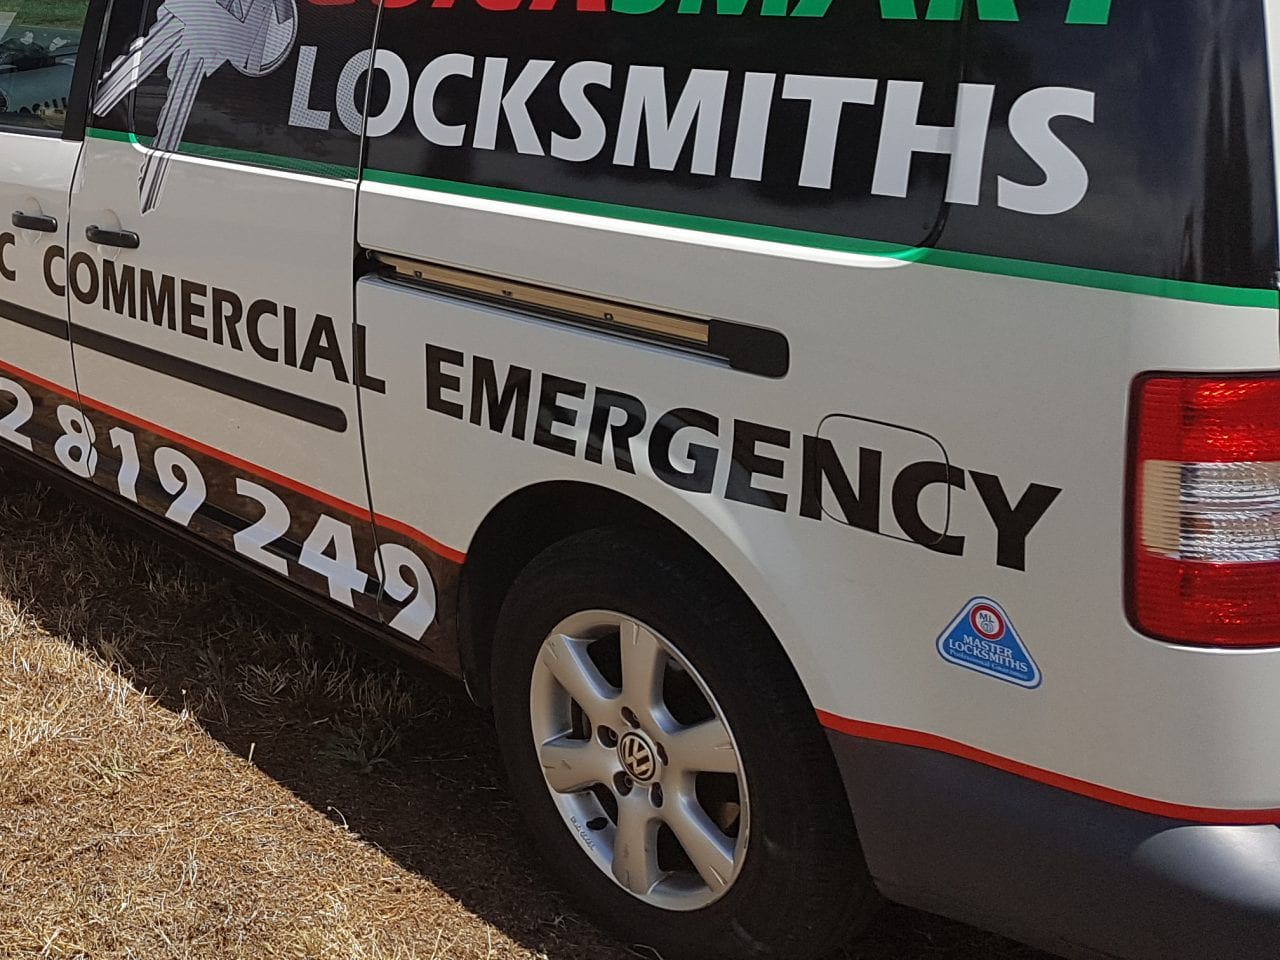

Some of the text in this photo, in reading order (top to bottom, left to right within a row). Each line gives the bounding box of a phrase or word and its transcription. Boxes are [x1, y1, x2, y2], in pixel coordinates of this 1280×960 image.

[287, 44, 1095, 216] LOCKSMITHS
[42, 245, 387, 395] COMMERCIAL
[425, 343, 1063, 572] EMERGENCY
[54, 404, 207, 527] 819
[233, 478, 438, 641] 249
[949, 639, 1028, 672] LOCKSMITHS
[963, 634, 1013, 658] MASTER
